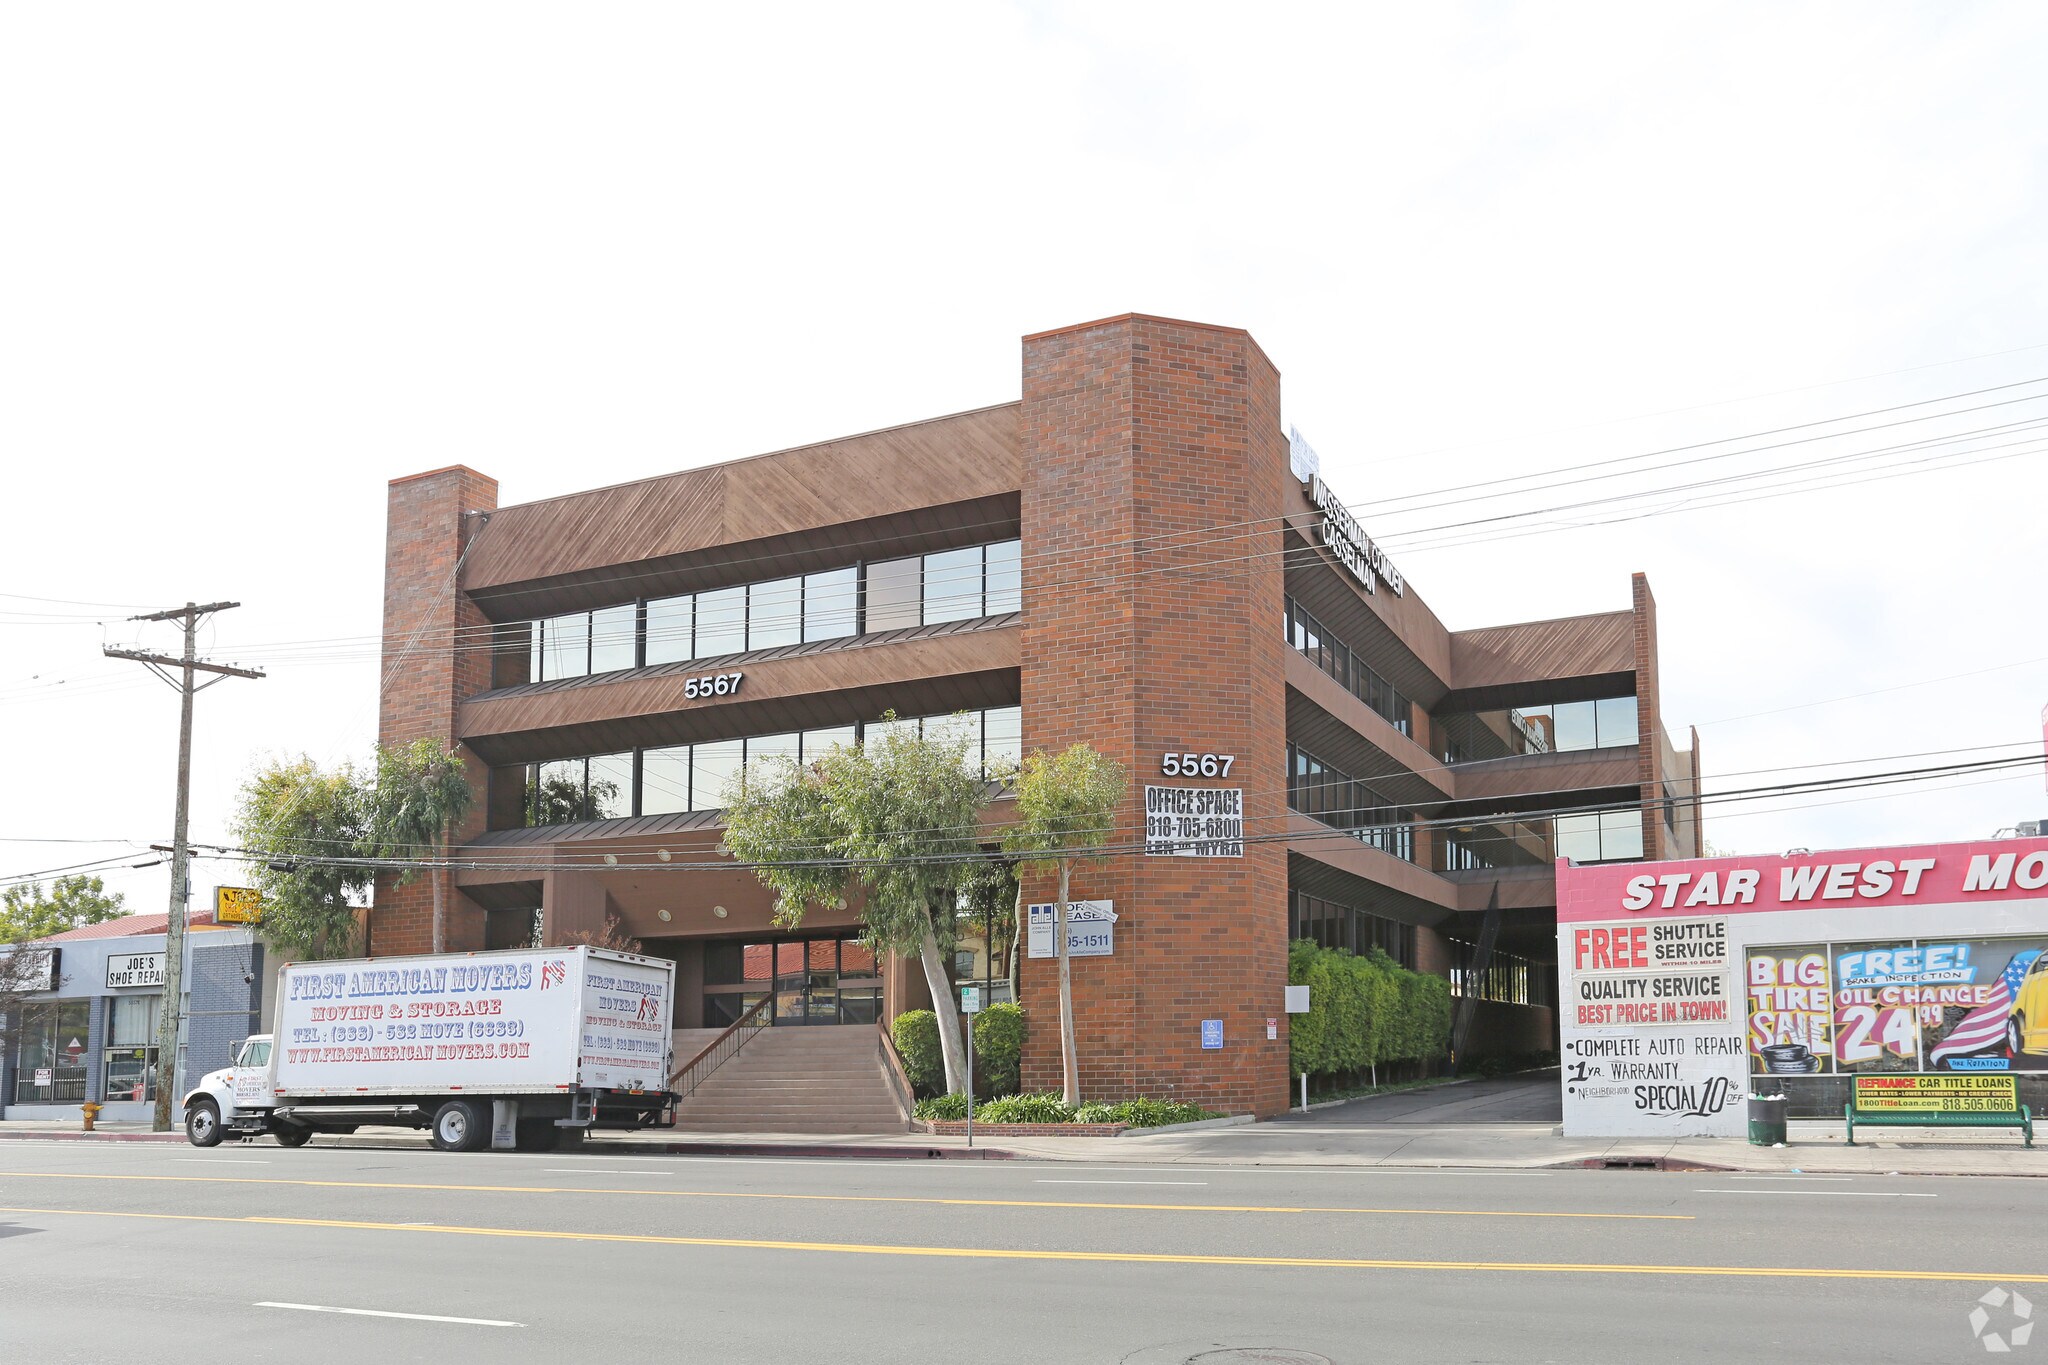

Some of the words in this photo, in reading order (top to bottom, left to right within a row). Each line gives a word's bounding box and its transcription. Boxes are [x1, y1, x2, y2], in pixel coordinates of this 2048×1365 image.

[1323, 518, 1375, 596] CASSELMAN
[1373, 544, 1404, 598] COMDEN
[684, 672, 743, 699] 5567
[1162, 752, 1235, 778] 5567
[1148, 787, 1194, 814] OFFICE
[1197, 790, 1240, 815] SPACE
[1148, 816, 1240, 838] 818-705-6800
[1195, 840, 1242, 856] MYRA
[1622, 868, 1761, 911] STAR
[1778, 858, 1936, 902] WEST
[1962, 850, 2048, 892] MO
[1066, 912, 1101, 921] EASE
[1574, 926, 1648, 970] FREE
[1654, 922, 1724, 941] SHUTTLE
[1655, 942, 1725, 960] SERVICE
[128, 956, 154, 970] JOE'S
[1747, 955, 1826, 986] BIG
[1839, 945, 1966, 979] FREE!
[109, 972, 132, 985] SHOE
[137, 970, 164, 984] REPAI
[290, 973, 346, 1000] FIRST
[348, 967, 448, 998] AMERICAN
[450, 962, 532, 992] MOVERS
[586, 974, 615, 991] FIRST
[616, 979, 662, 996] AMERICAN
[1580, 979, 1647, 1001] QUALITY
[1652, 976, 1720, 998] SERVICE
[1846, 977, 1876, 986] BRAKE
[1885, 972, 1962, 983] INSPECTION
[599, 996, 636, 1012] MOVERS
[1748, 986, 1829, 1012] TIRE
[1836, 988, 1875, 1007] OIL
[1879, 986, 1990, 1006] CHANGE
[310, 1004, 384, 1022] MOVING
[388, 1004, 402, 1018] &
[407, 999, 502, 1018] STORAGE
[1578, 1004, 1612, 1024] BEST
[1616, 1002, 1658, 1022] PRICE
[1662, 1002, 1676, 1022] IN
[1680, 1000, 1726, 1020] TOWN!
[331, 1024, 374, 1042] (888)
[420, 1022, 464, 1039] MOVE
[468, 1020, 524, 1038] (6683)
[586, 1016, 617, 1026] MOVING
[626, 1020, 662, 1032] STORAGE
[1749, 1010, 1831, 1055] SALE
[1576, 1038, 1640, 1056] COMPLETE
[1648, 1038, 1684, 1055] AUTO
[1695, 1037, 1743, 1055] REPAIR
[1568, 1061, 1588, 1082] 1
[1967, 1058, 2006, 1068] ROTATION
[1858, 1078, 1916, 1088] REFINANCE
[1920, 1078, 1940, 1088] CAR
[1944, 1078, 1972, 1088] TITLE
[1976, 1078, 2012, 1088] LOANS
[1634, 1085, 1698, 1111] SPECIAL
[1726, 1094, 1744, 1102] OFF
[1942, 1099, 2014, 1110] 818.505.0606
